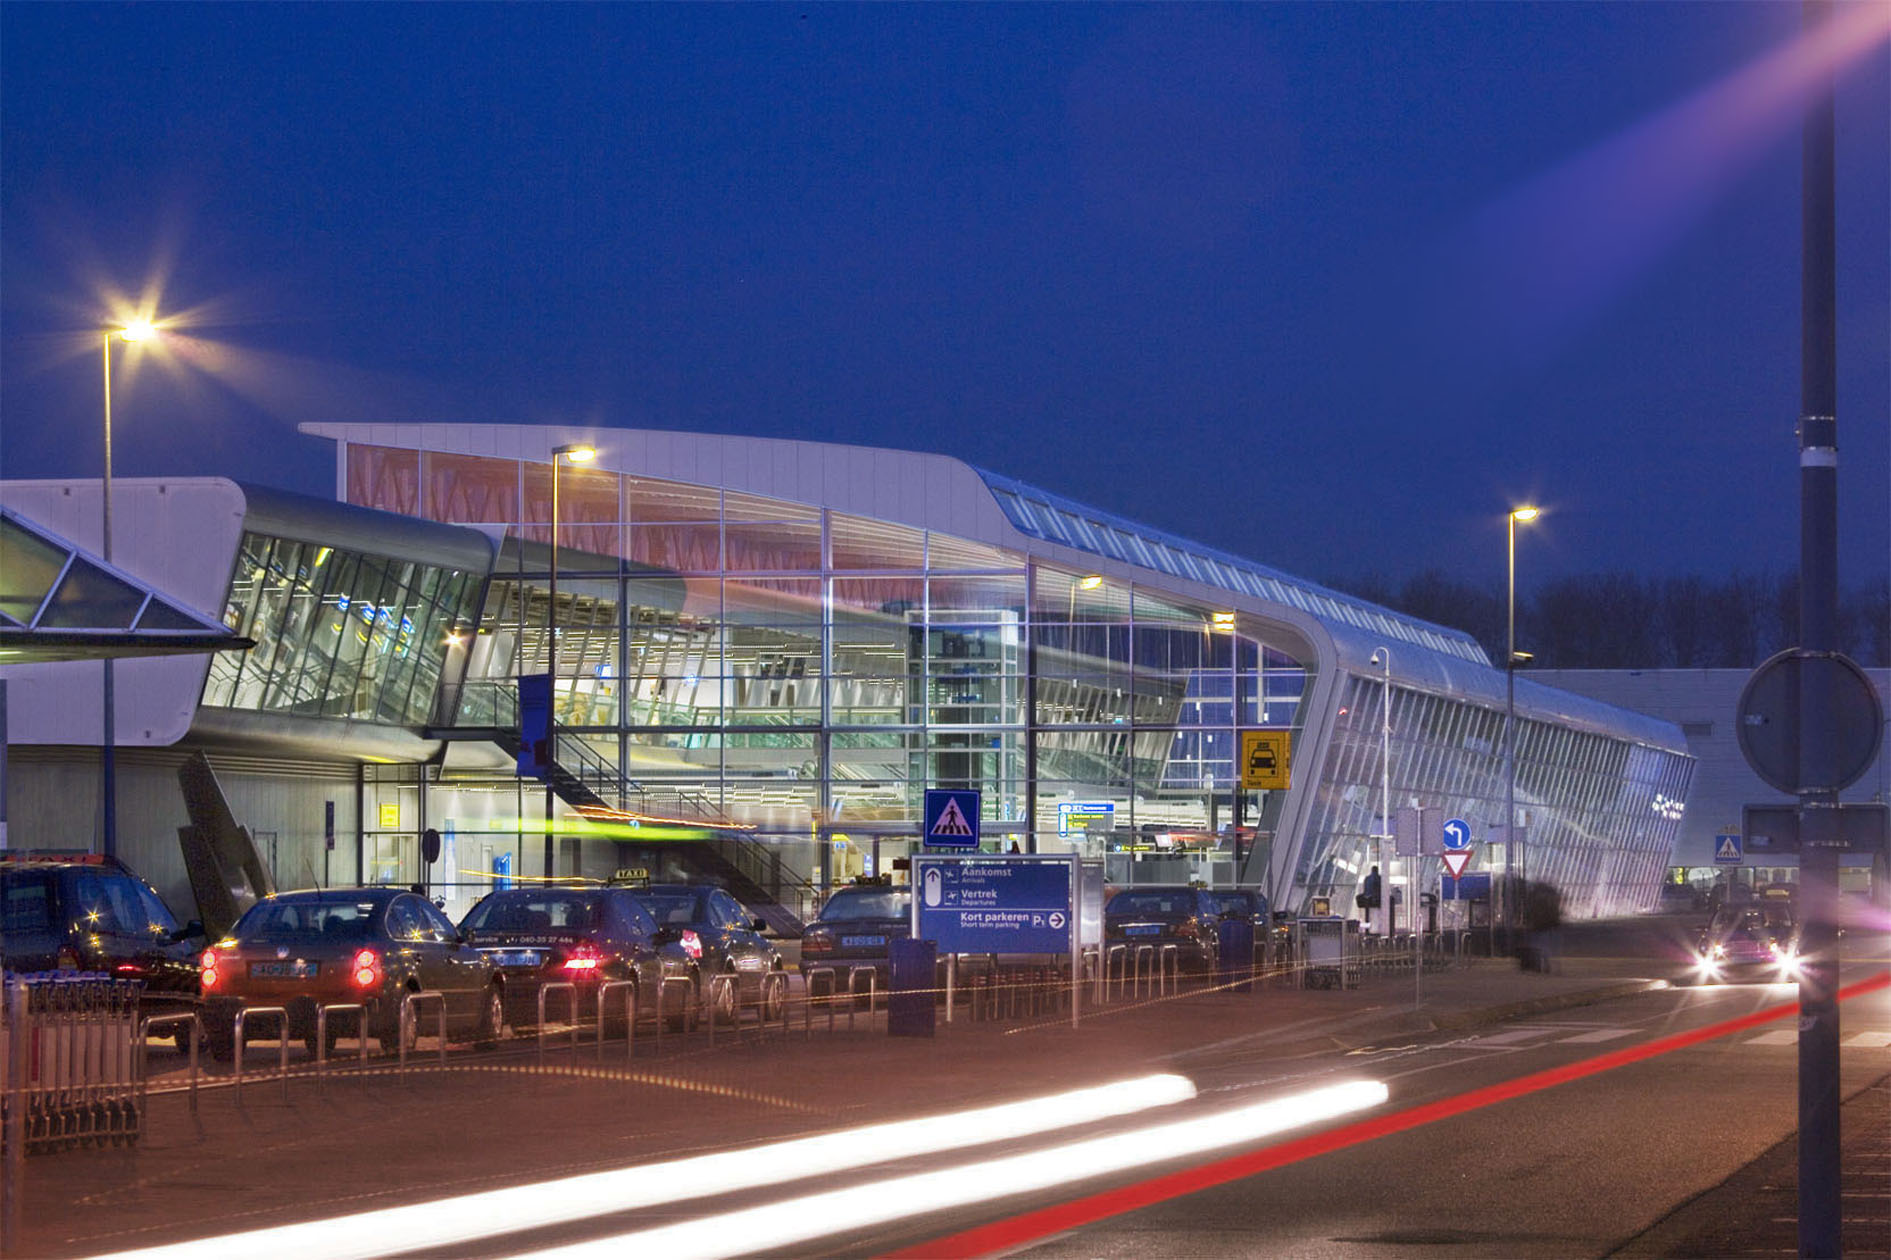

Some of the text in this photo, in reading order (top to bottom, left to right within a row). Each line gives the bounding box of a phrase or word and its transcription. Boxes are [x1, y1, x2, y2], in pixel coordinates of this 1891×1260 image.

[618, 869, 644, 878] TAXI
[961, 867, 1012, 877] Aankomst
[961, 889, 998, 898] Vertrek
[960, 911, 1029, 923] Kort parkeren
[995, 921, 1020, 930] parking
